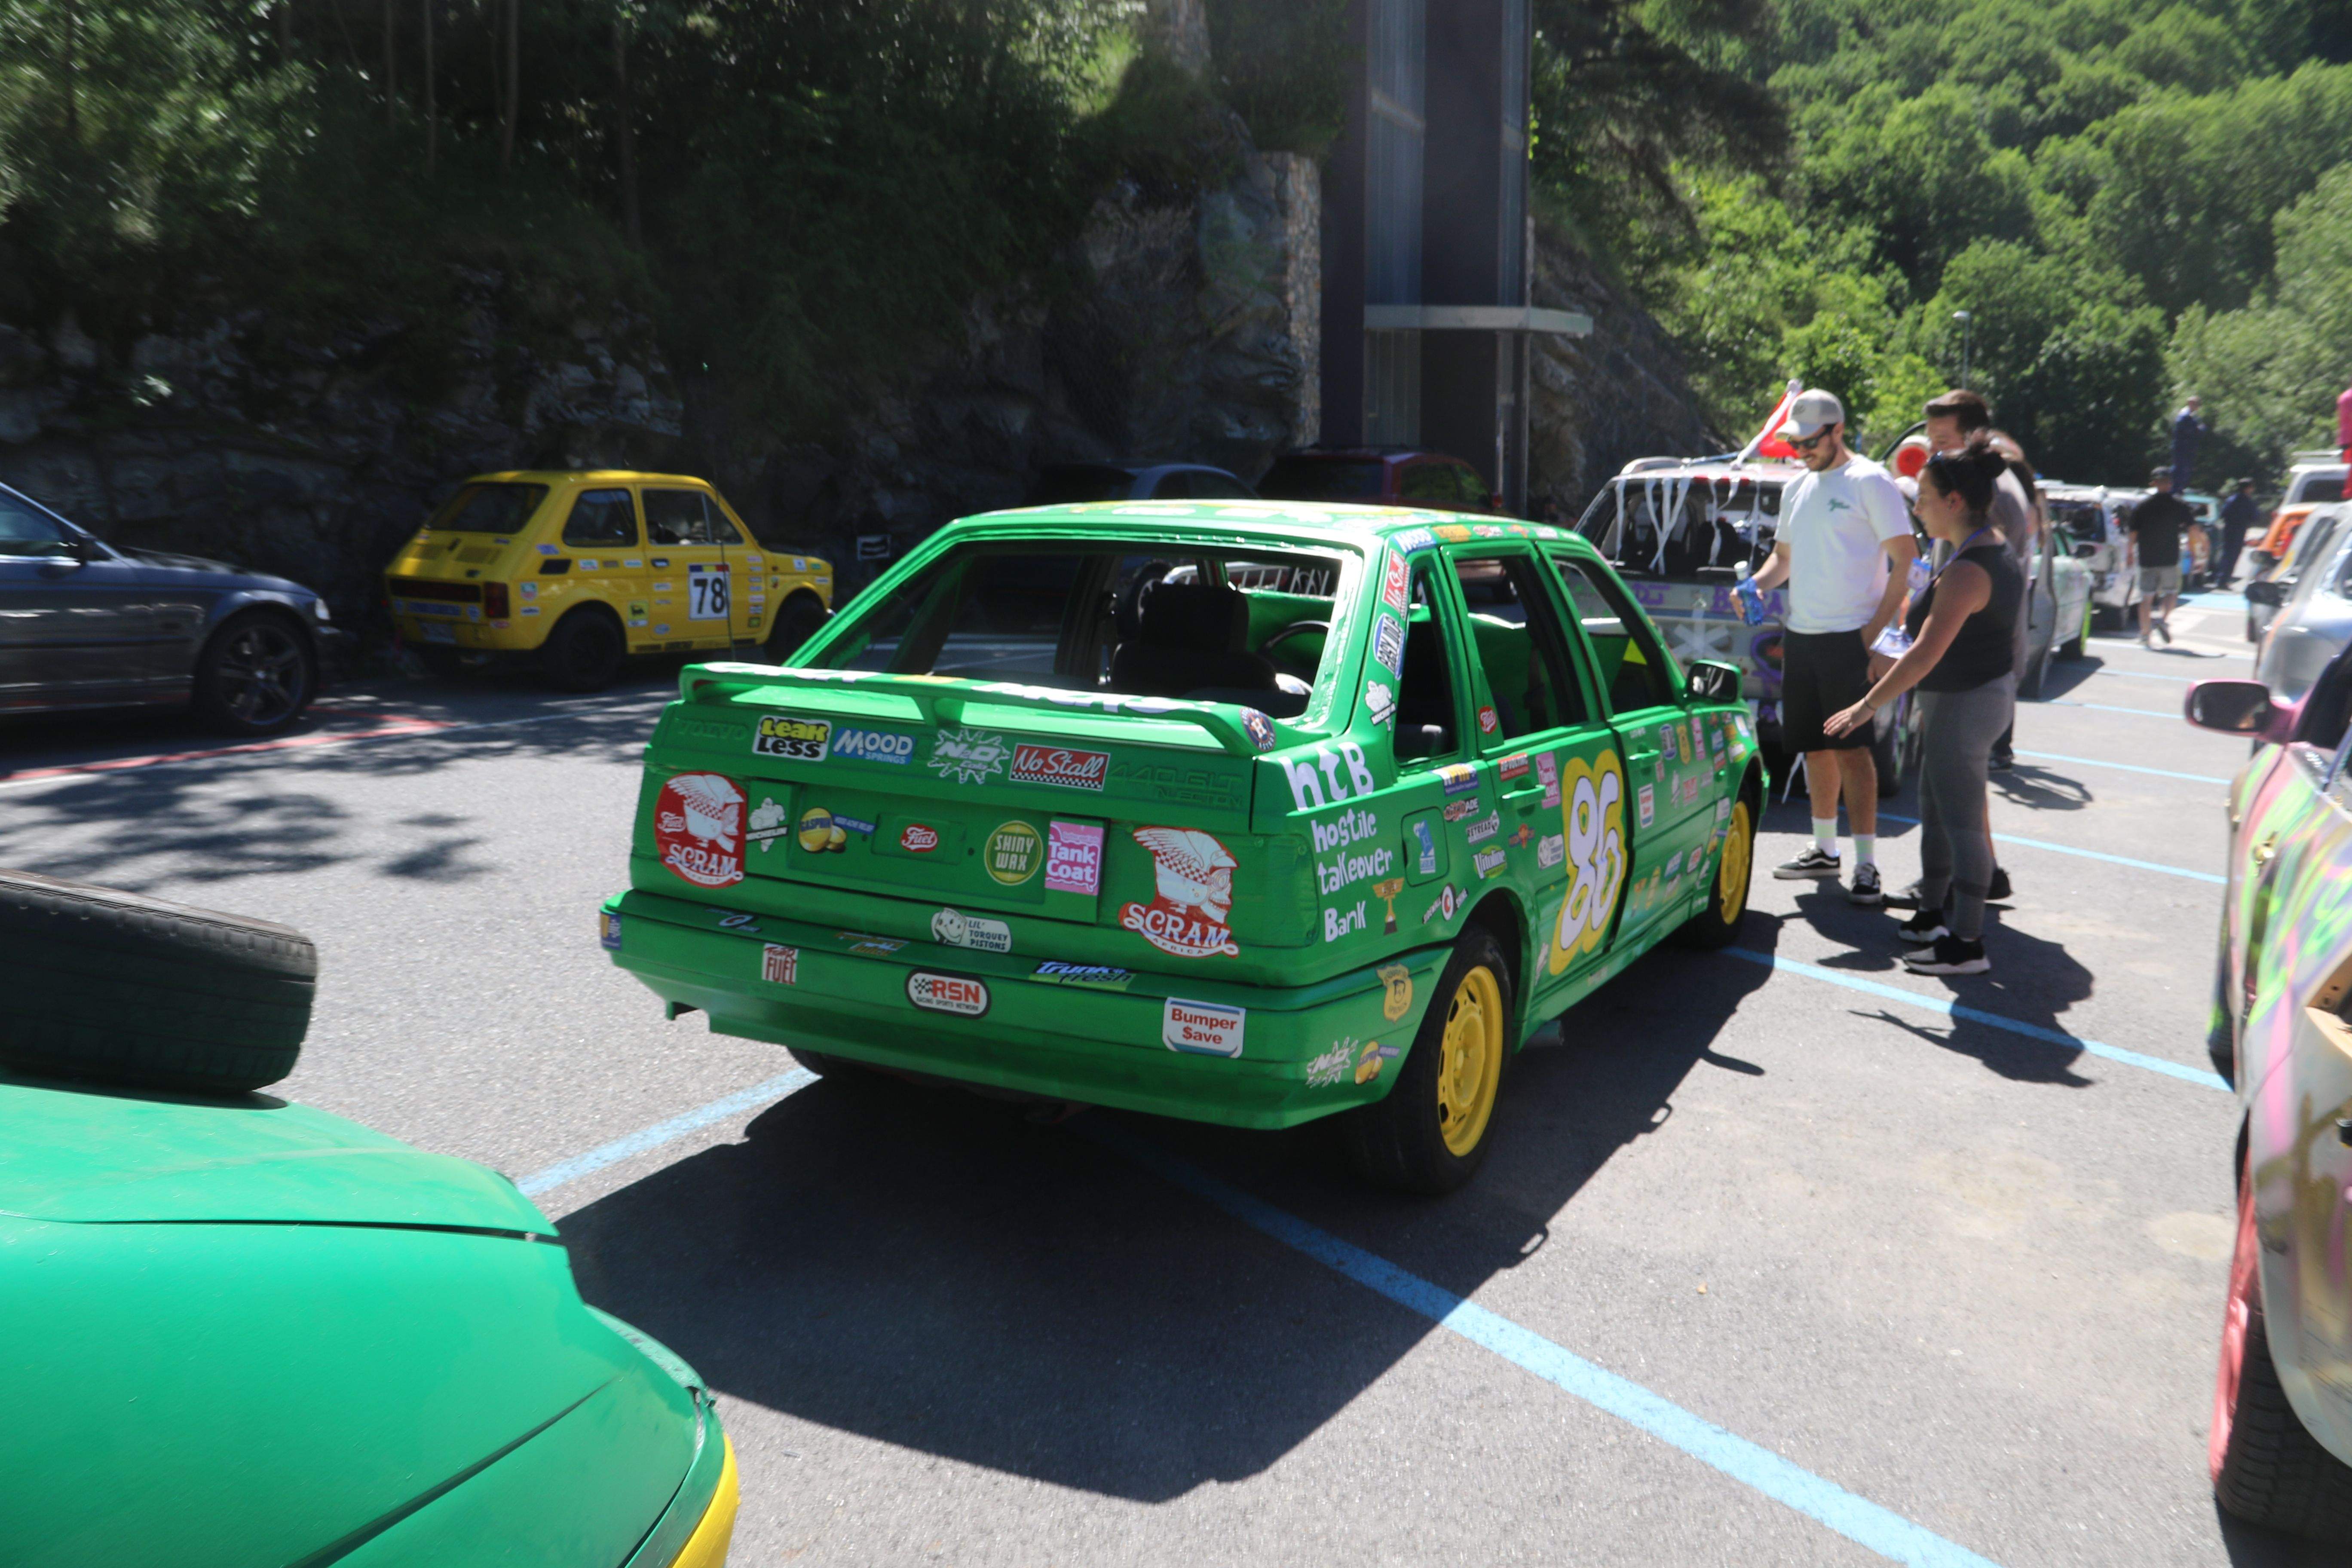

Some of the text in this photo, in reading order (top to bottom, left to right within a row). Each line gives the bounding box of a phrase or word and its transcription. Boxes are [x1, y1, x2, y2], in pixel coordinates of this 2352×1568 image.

[693, 578, 726, 614] 78
[833, 729, 913, 756] MOOD
[865, 752, 906, 764] SPRINGS
[1014, 749, 1105, 778] No Stall
[995, 834, 1035, 854] SHINY
[1048, 841, 1096, 864] Tank
[666, 843, 739, 876] SCRAM
[995, 852, 1028, 871] WAX
[1046, 859, 1094, 882] Coat
[1559, 770, 1623, 951] 86
[969, 929, 1008, 941] TORQUEY
[1123, 903, 1232, 948] SCRAM
[970, 939, 1006, 950] PISTONS
[1152, 937, 1204, 955] AFRICA
[766, 956, 798, 986] FUEL
[931, 979, 980, 1004] RSN
[1171, 1008, 1237, 1031] Bumper
